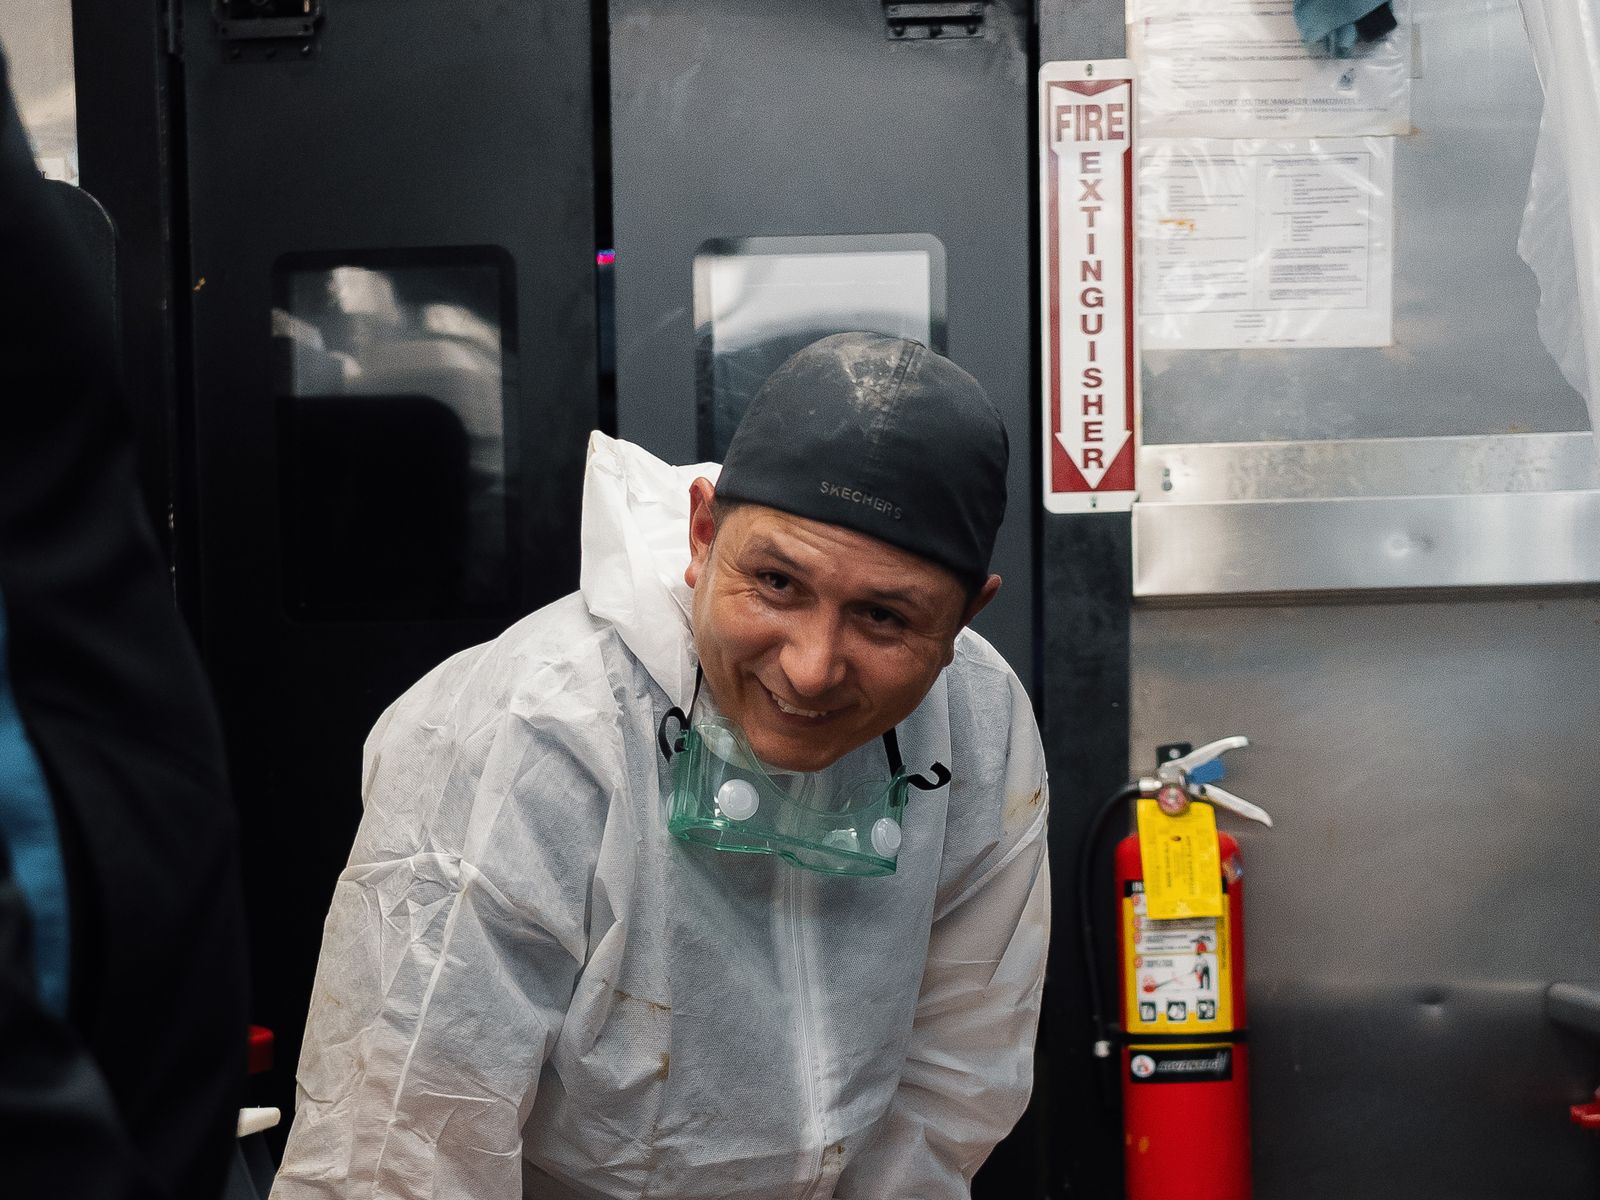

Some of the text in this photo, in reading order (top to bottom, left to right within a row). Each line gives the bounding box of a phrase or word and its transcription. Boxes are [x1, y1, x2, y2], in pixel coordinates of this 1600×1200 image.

[1055, 103, 1125, 142] FIRE
[1078, 151, 1104, 469] EXTINGUISHER
[820, 480, 903, 520] SKECHERS
